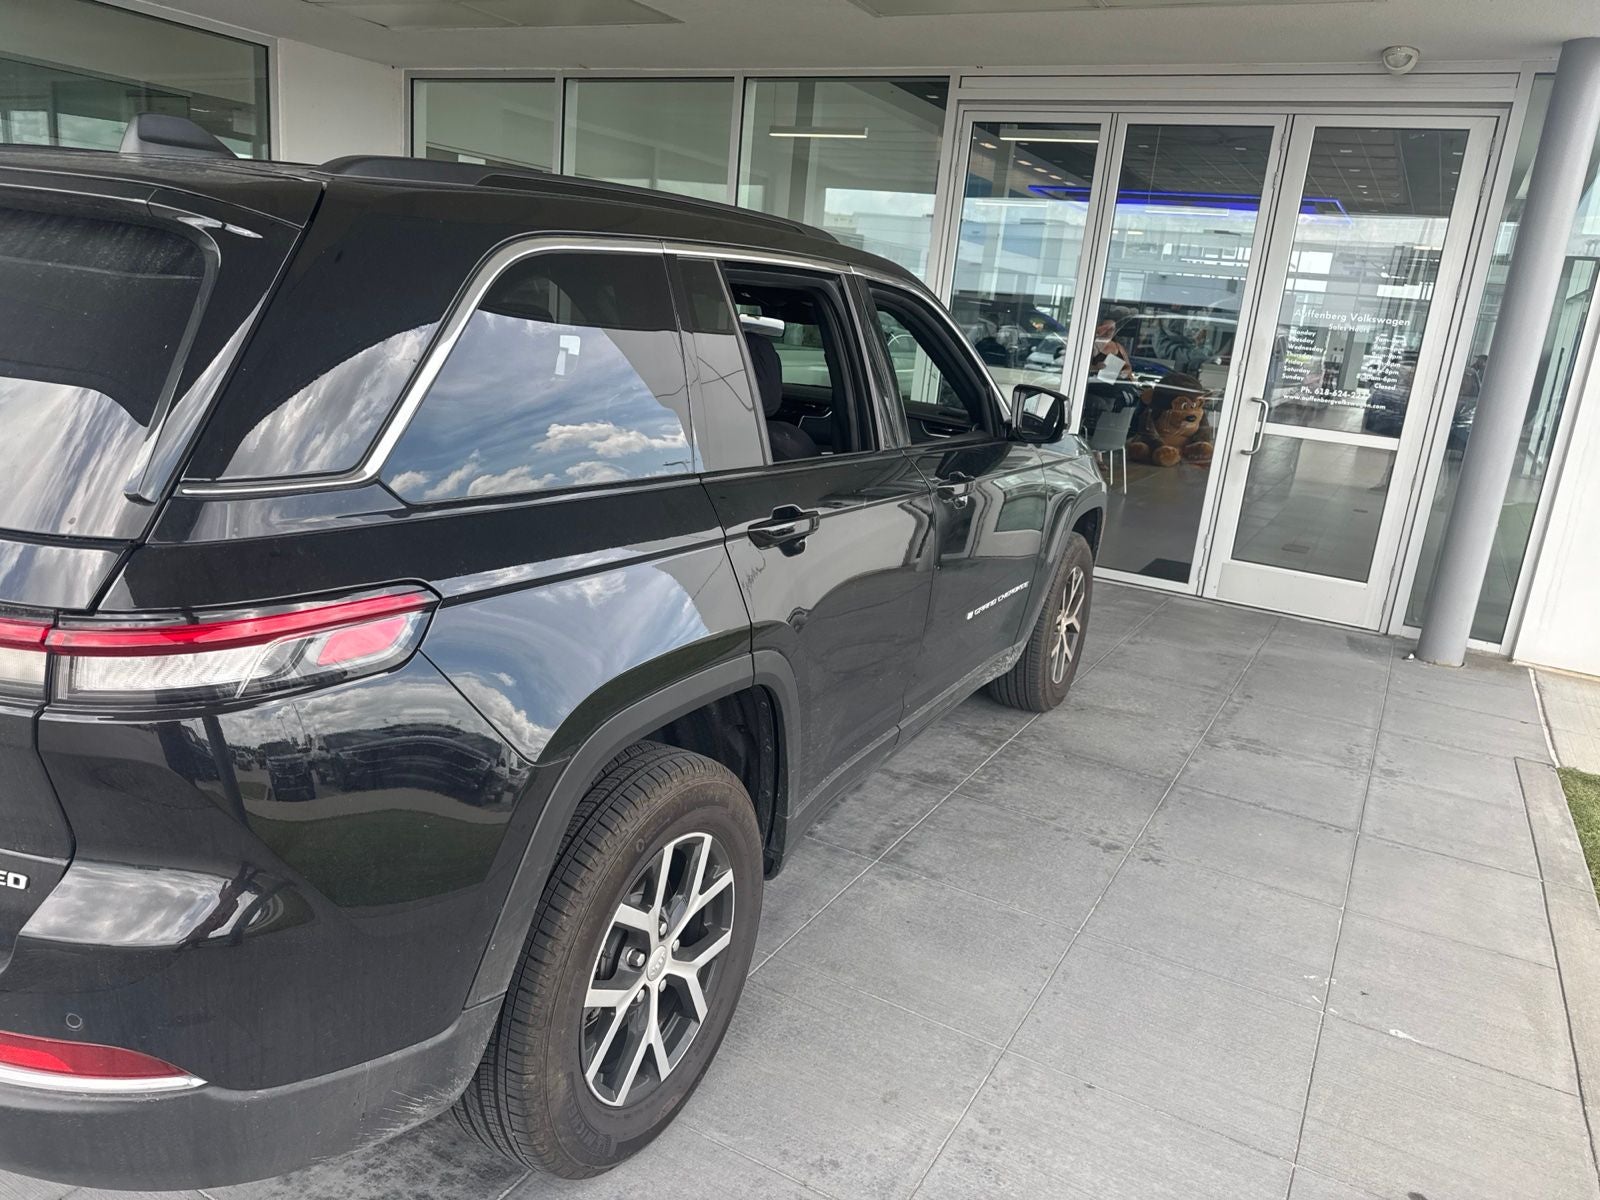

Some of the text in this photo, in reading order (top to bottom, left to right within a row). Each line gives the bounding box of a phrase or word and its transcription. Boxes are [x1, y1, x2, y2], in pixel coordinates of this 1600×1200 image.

[1294, 309, 1411, 327] Auffenberg Volkswagen
[1328, 323, 1347, 331] Sales
[1290, 329, 1316, 337] Monday
[1287, 343, 1324, 353] Wednesday
[1286, 350, 1313, 360] Thursday
[1285, 358, 1304, 367] Friday
[1284, 365, 1310, 375] Saturday
[1282, 373, 1397, 391] Sunday Closed
[1300, 386, 1312, 394] Ph.
[1283, 393, 1386, 409] www.auffenbergvolkswagen.com
